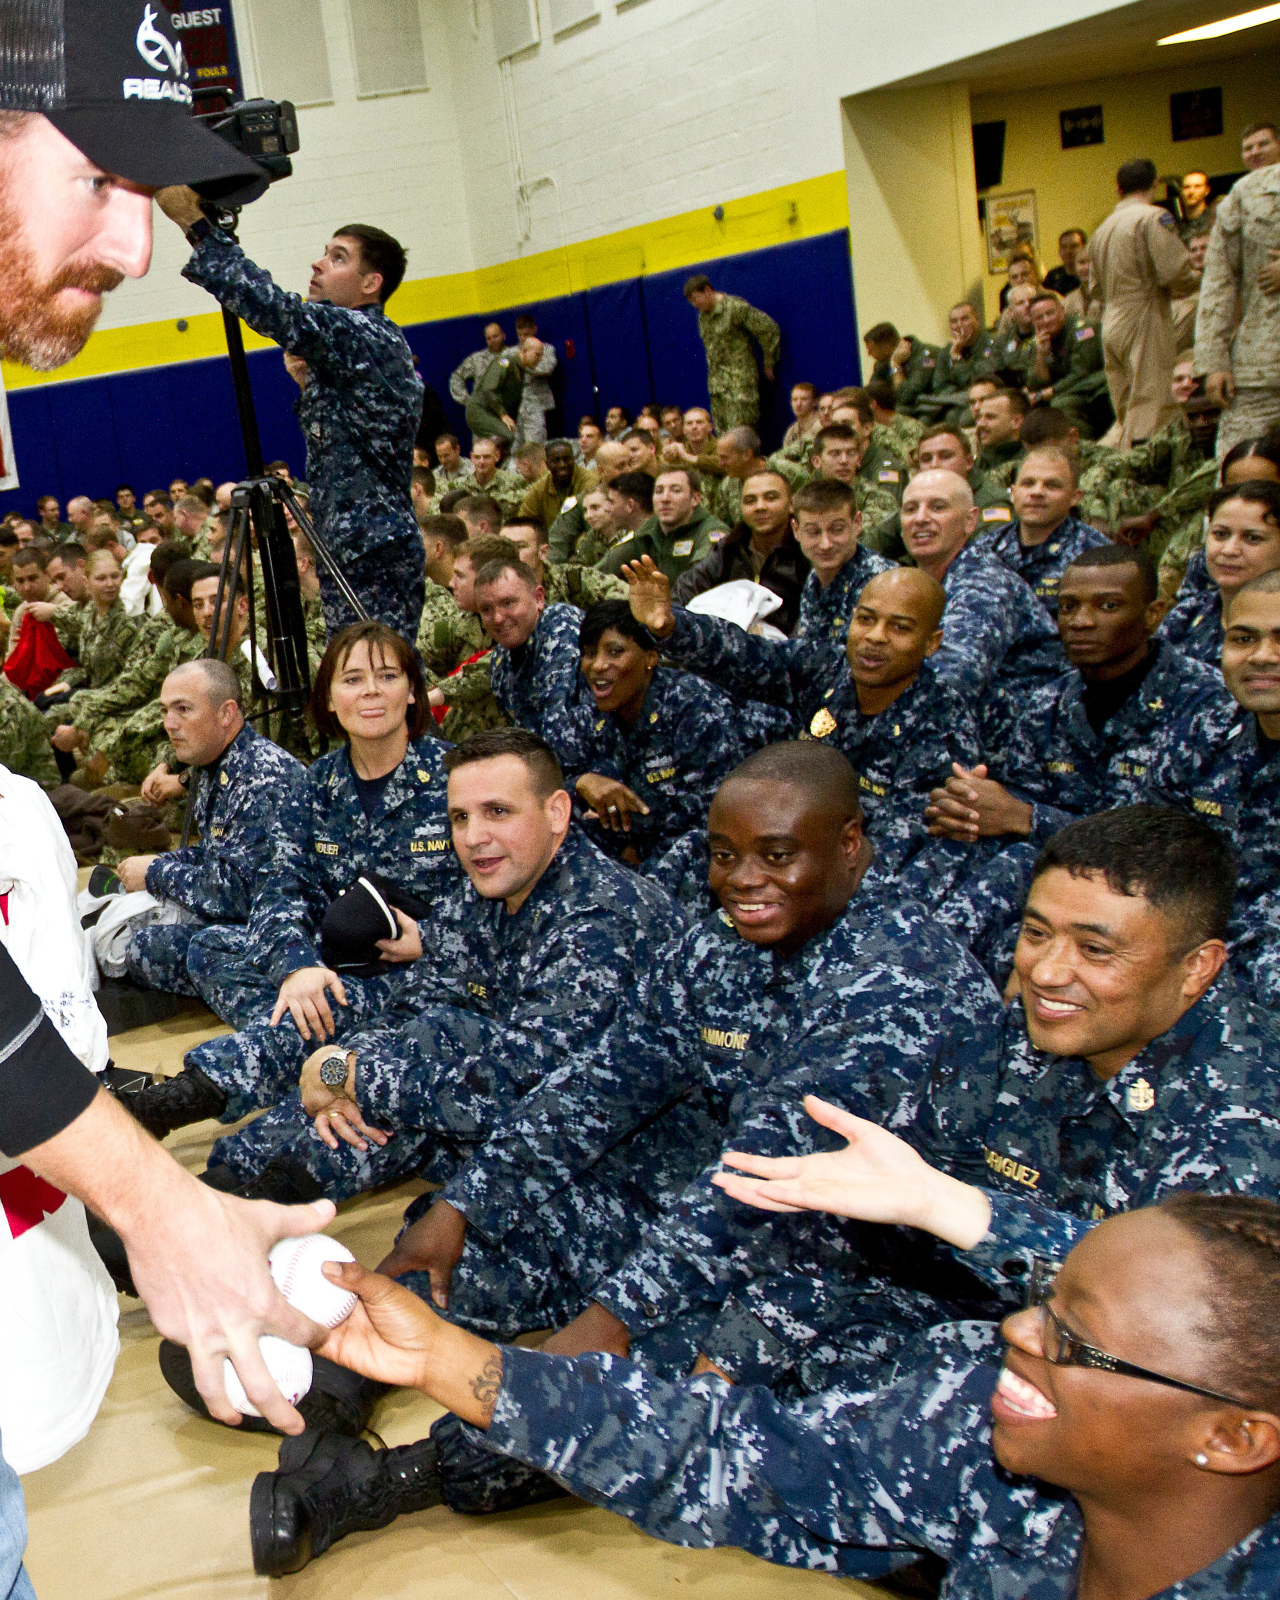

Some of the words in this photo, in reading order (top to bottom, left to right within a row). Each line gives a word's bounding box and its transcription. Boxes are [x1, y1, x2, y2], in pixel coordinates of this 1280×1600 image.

[170, 8, 221, 29] GUEST
[196, 65, 228, 78] FOULS
[410, 841, 426, 853] U.S.
[427, 839, 450, 852] NAVY
